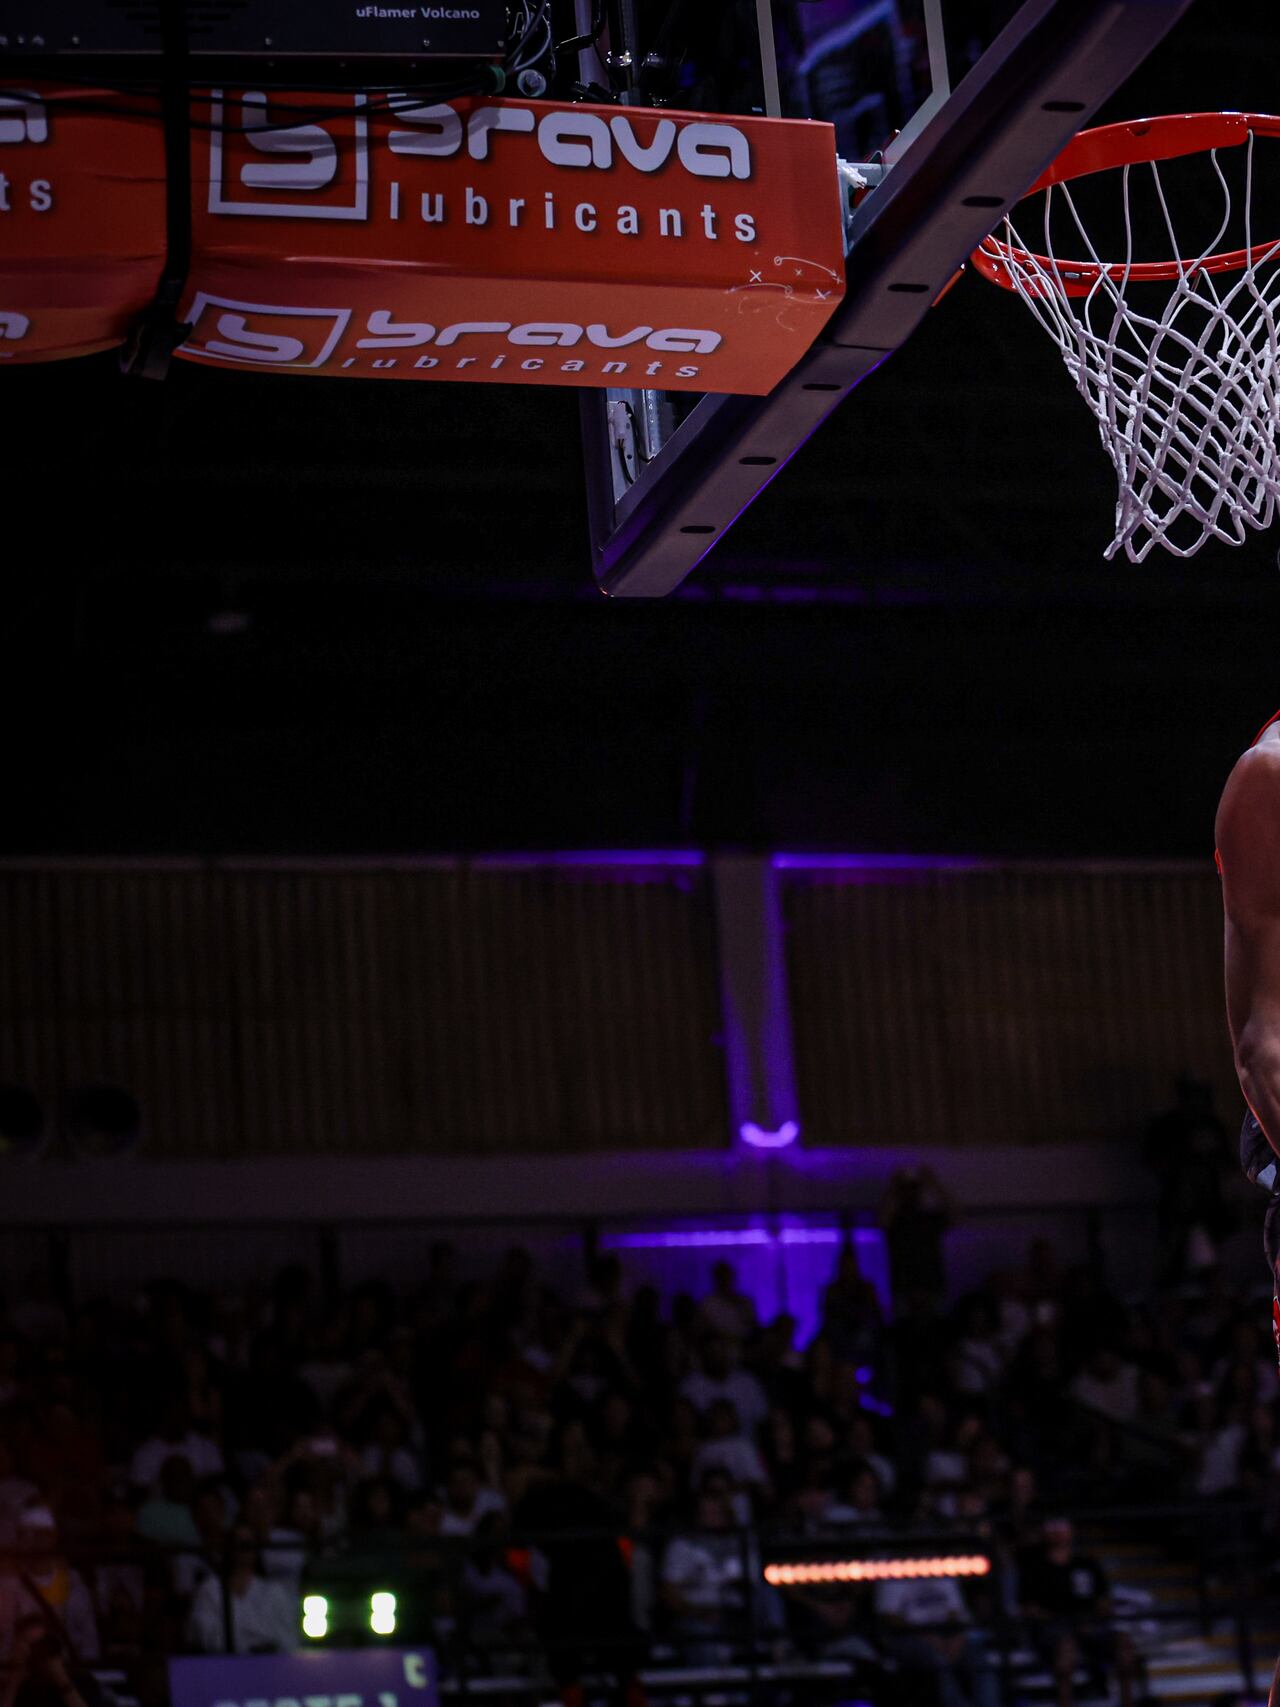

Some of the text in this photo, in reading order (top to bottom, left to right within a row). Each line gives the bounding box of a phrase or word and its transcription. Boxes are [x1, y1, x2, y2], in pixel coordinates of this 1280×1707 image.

[356, 6, 480, 19] uFlamer Volcano
[389, 182, 756, 242] lubricants
[355, 310, 722, 354] brava
[342, 355, 699, 378] lubricants
